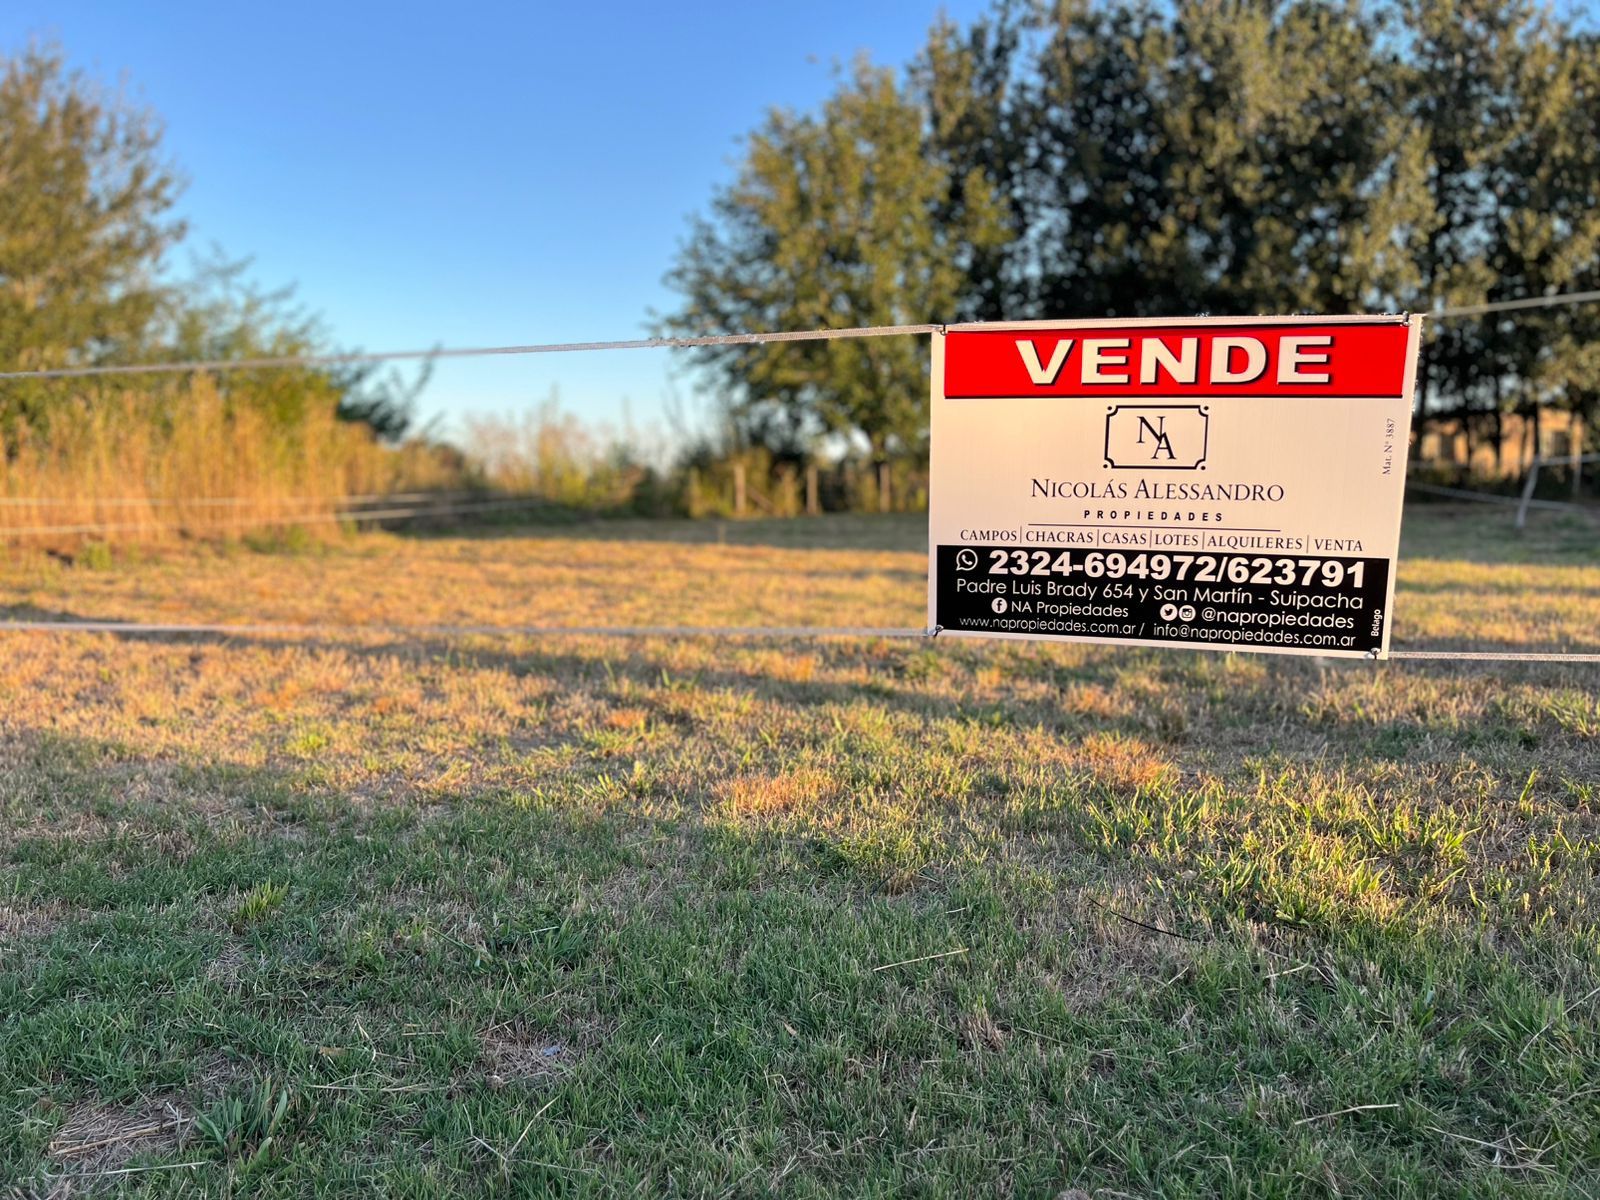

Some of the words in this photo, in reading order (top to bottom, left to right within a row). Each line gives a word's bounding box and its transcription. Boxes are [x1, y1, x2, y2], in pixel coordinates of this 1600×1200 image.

[1015, 335, 1333, 385] VENDE
[1385, 418, 1396, 438] 3887
[1031, 478, 1128, 499] NICOLÁS
[1134, 478, 1284, 502] ALESSANDRO
[1083, 510, 1223, 522] PROPIEDADES
[960, 529, 1017, 542] CAMPOS
[1025, 530, 1094, 543] CHACRAS
[1102, 532, 1147, 545] CASAS
[1154, 533, 1199, 546] LOTES
[1207, 535, 1303, 550] ALQUILERES
[1314, 538, 1363, 552] VENTA
[988, 549, 1365, 588] 2324-694972/623791
[956, 579, 1007, 594] Padre
[1012, 581, 1041, 596] Luis
[1047, 582, 1098, 600] Brady
[1103, 584, 1133, 599] 654
[1139, 588, 1149, 602] y
[1153, 585, 1188, 601] San
[1193, 587, 1252, 604] Martín
[1270, 589, 1363, 610] Suipacha
[1011, 601, 1032, 613] NA
[1036, 602, 1129, 618] Propiedades
[1201, 607, 1354, 629] @napropiedades
[959, 617, 1136, 635] www.napropiedades.com.ar
[1153, 624, 1356, 647] info@napropiedades.com.ar
[1371, 609, 1381, 637] Belago
